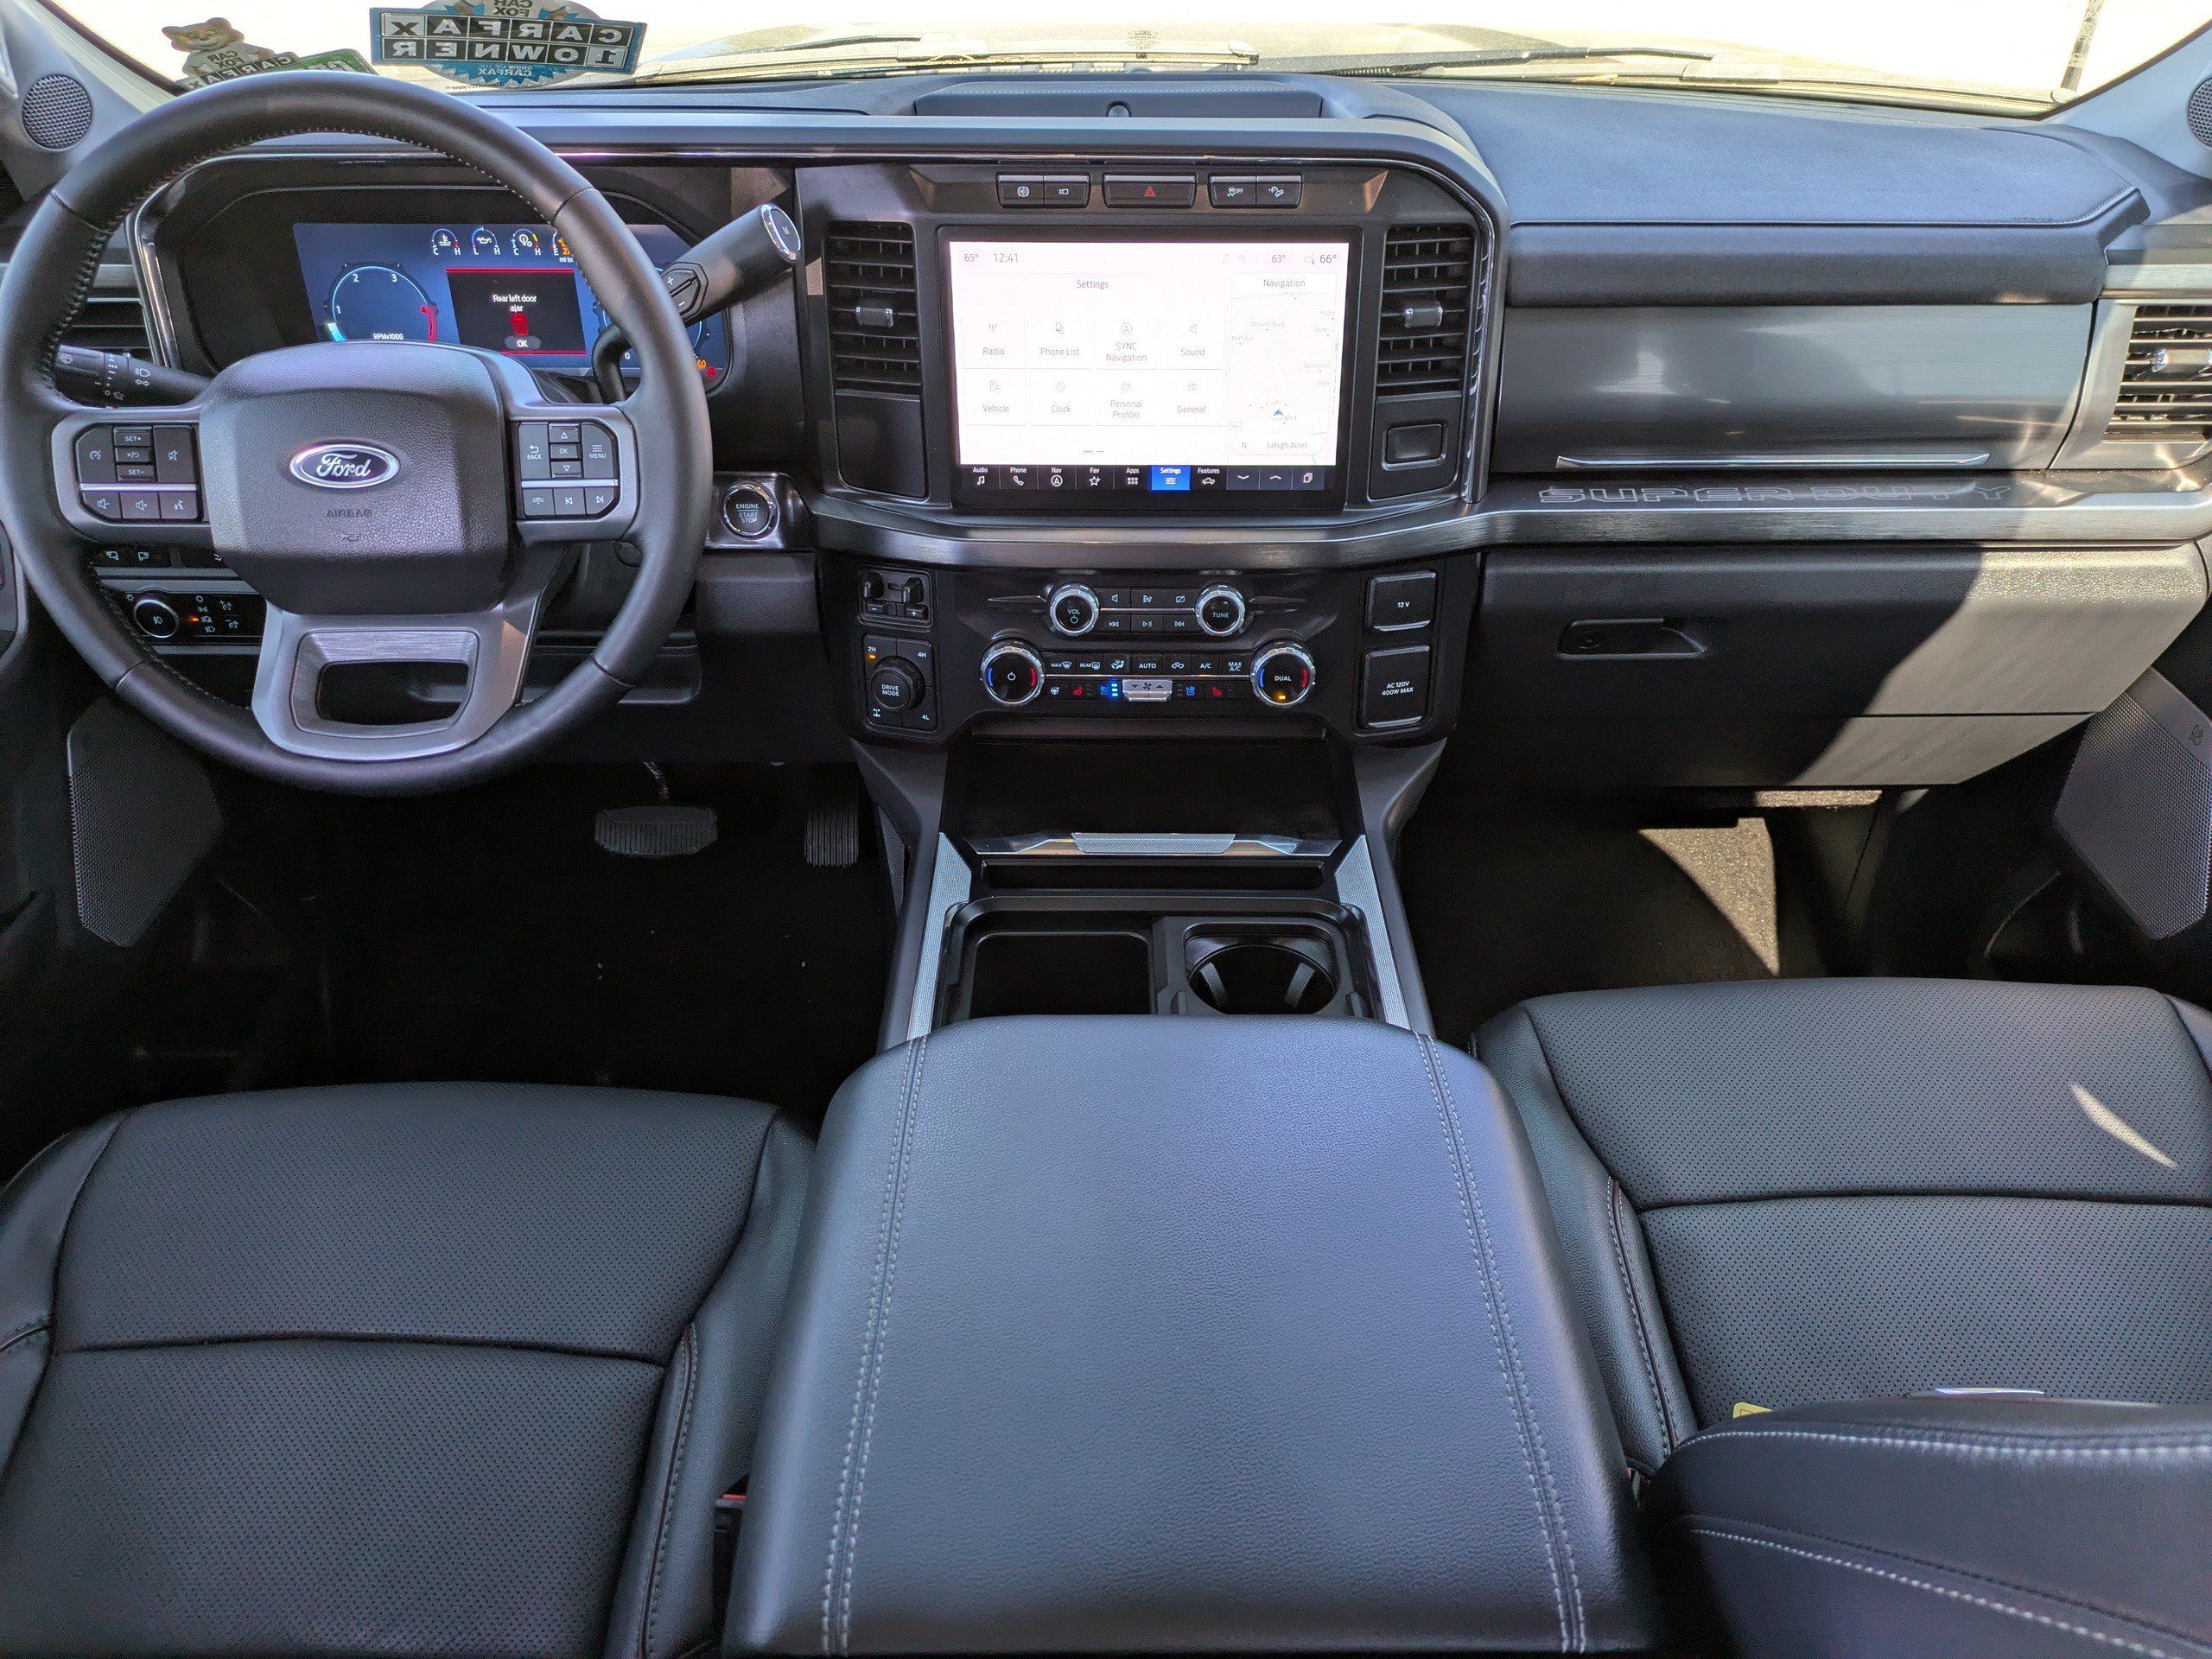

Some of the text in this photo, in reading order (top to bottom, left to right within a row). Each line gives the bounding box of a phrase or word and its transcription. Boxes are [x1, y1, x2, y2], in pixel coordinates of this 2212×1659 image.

[433, 247, 439, 256] C
[454, 247, 461, 256] H
[553, 247, 559, 256] E
[964, 252, 979, 263] 65°
[993, 252, 1019, 263] 12:41
[1271, 254, 1286, 264] 63°
[1319, 254, 1337, 264] 66°
[353, 273, 359, 283] 2
[391, 273, 397, 283] 3
[1076, 279, 1109, 290] Settings
[1263, 278, 1306, 289] Navigation
[493, 294, 537, 302] Rear left door
[335, 305, 341, 314] 1
[510, 304, 524, 314] ajar
[982, 346, 1005, 355] Radio
[1116, 341, 1137, 351] SYNC
[1040, 347, 1080, 356] Phone List
[1180, 347, 1205, 356] Sound
[1106, 353, 1147, 363] Navigation
[1110, 399, 1143, 408] Personal
[982, 404, 1009, 413] Vehicle
[1051, 404, 1071, 413] Clock
[1177, 405, 1206, 414] General
[1112, 410, 1141, 419] Profiles
[1267, 442, 1288, 450] Lehigh
[316, 453, 372, 477] Ford
[1538, 486, 2011, 503] SUPER DUTY
[326, 508, 372, 518] AIRBAG
